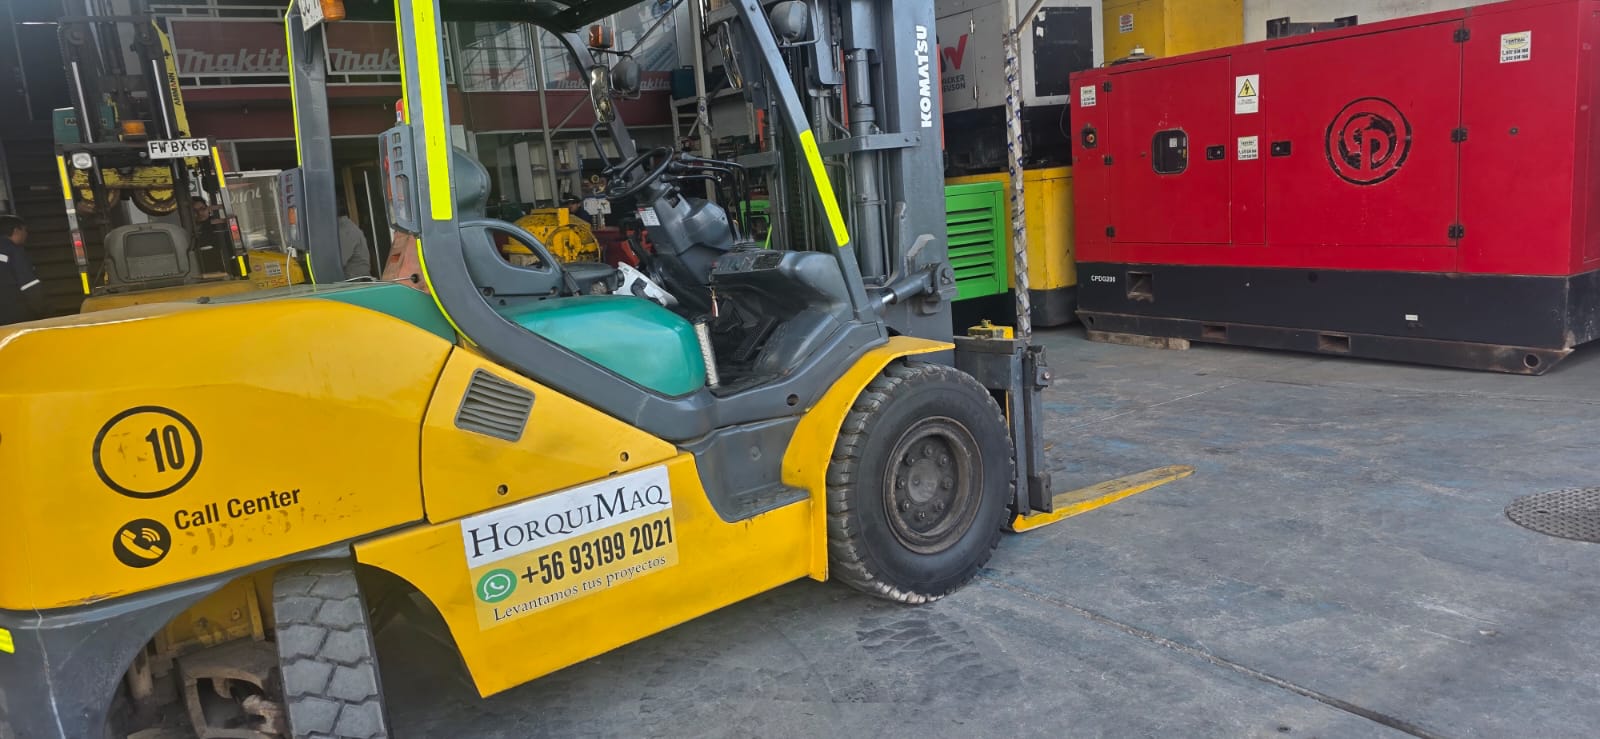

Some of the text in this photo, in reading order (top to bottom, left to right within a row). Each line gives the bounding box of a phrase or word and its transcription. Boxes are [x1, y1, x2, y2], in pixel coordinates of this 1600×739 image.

[914, 25, 932, 128] KOMATSU
[145, 424, 185, 473] 10
[174, 488, 301, 530] Call Center
[520, 517, 673, 586] +56 93199 2021
[494, 555, 666, 622] Levantamos tus proyectos
